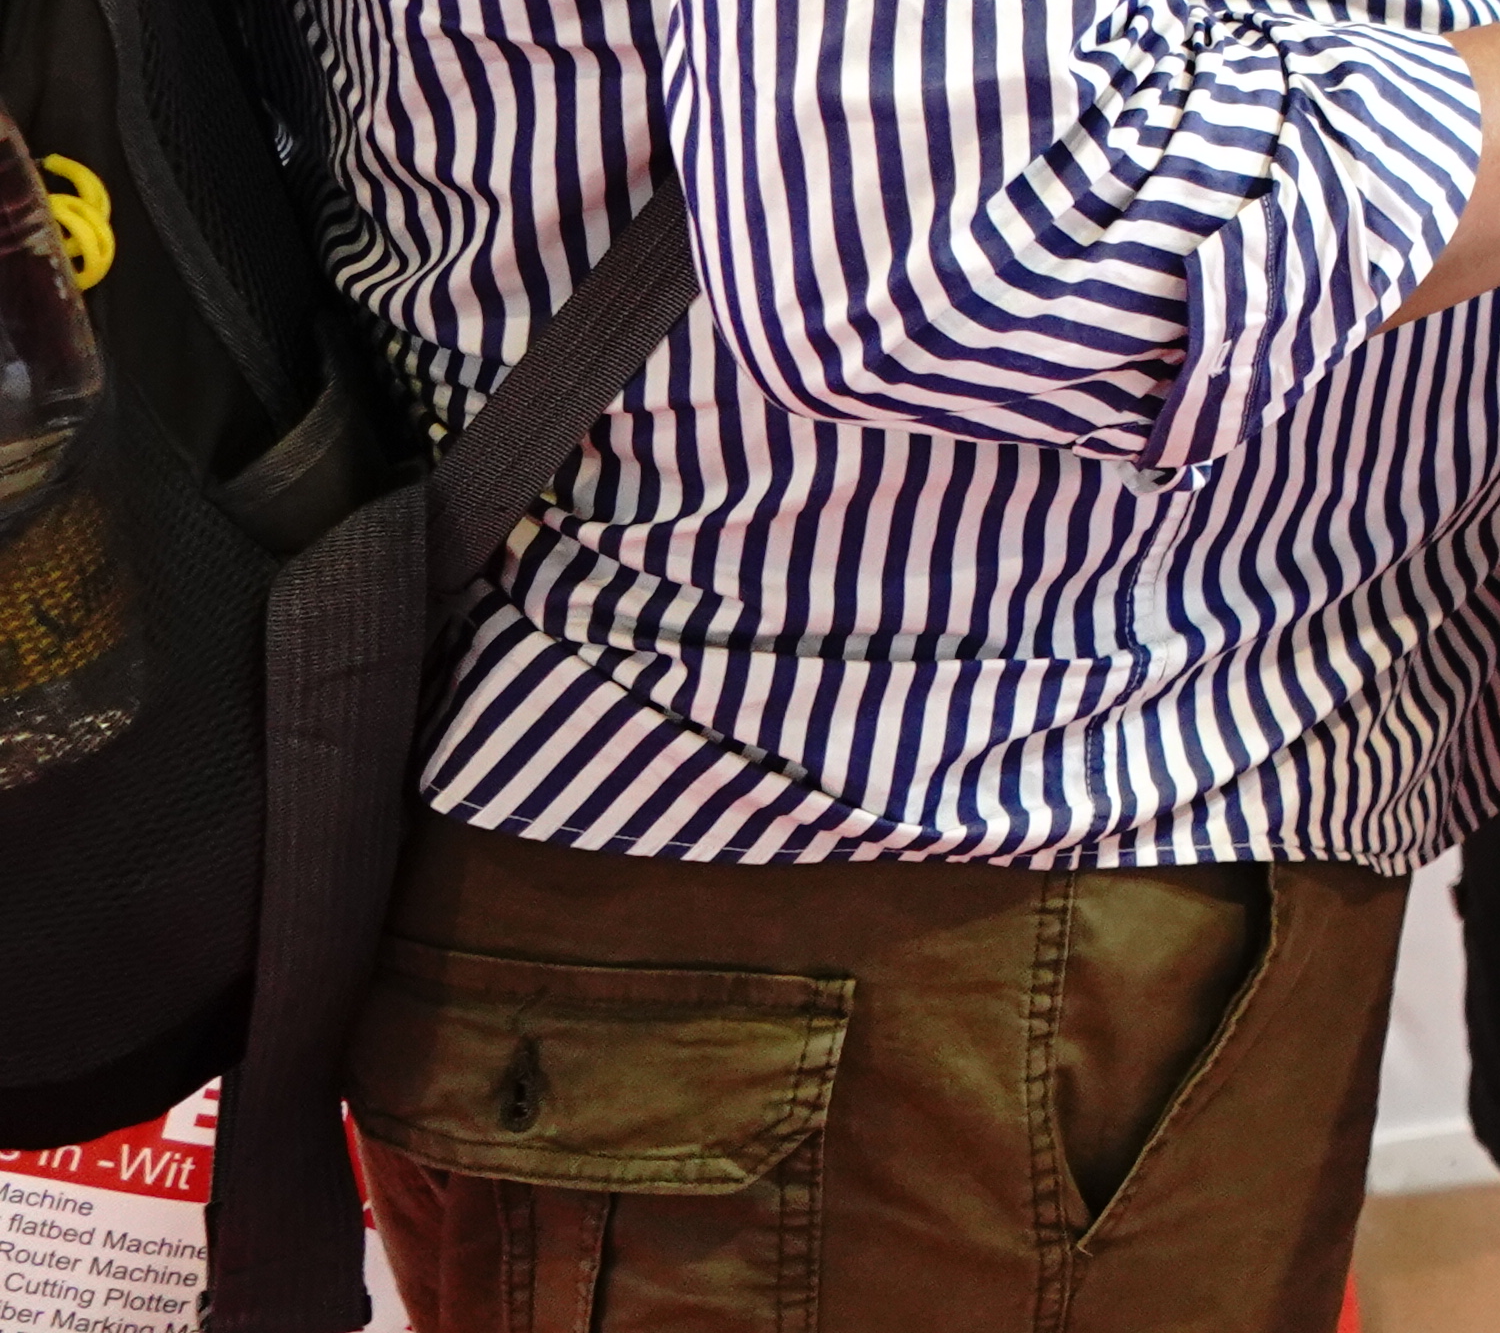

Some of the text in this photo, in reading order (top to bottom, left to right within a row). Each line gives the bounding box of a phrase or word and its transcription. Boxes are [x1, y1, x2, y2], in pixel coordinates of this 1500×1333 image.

[97, 1143, 196, 1190] -Wit
[7, 1213, 207, 1261] flatbed Machine
[0, 1240, 199, 1288] Router Machine
[0, 1299, 44, 1325] ber
[5, 1272, 191, 1315] Cutting Plotter
